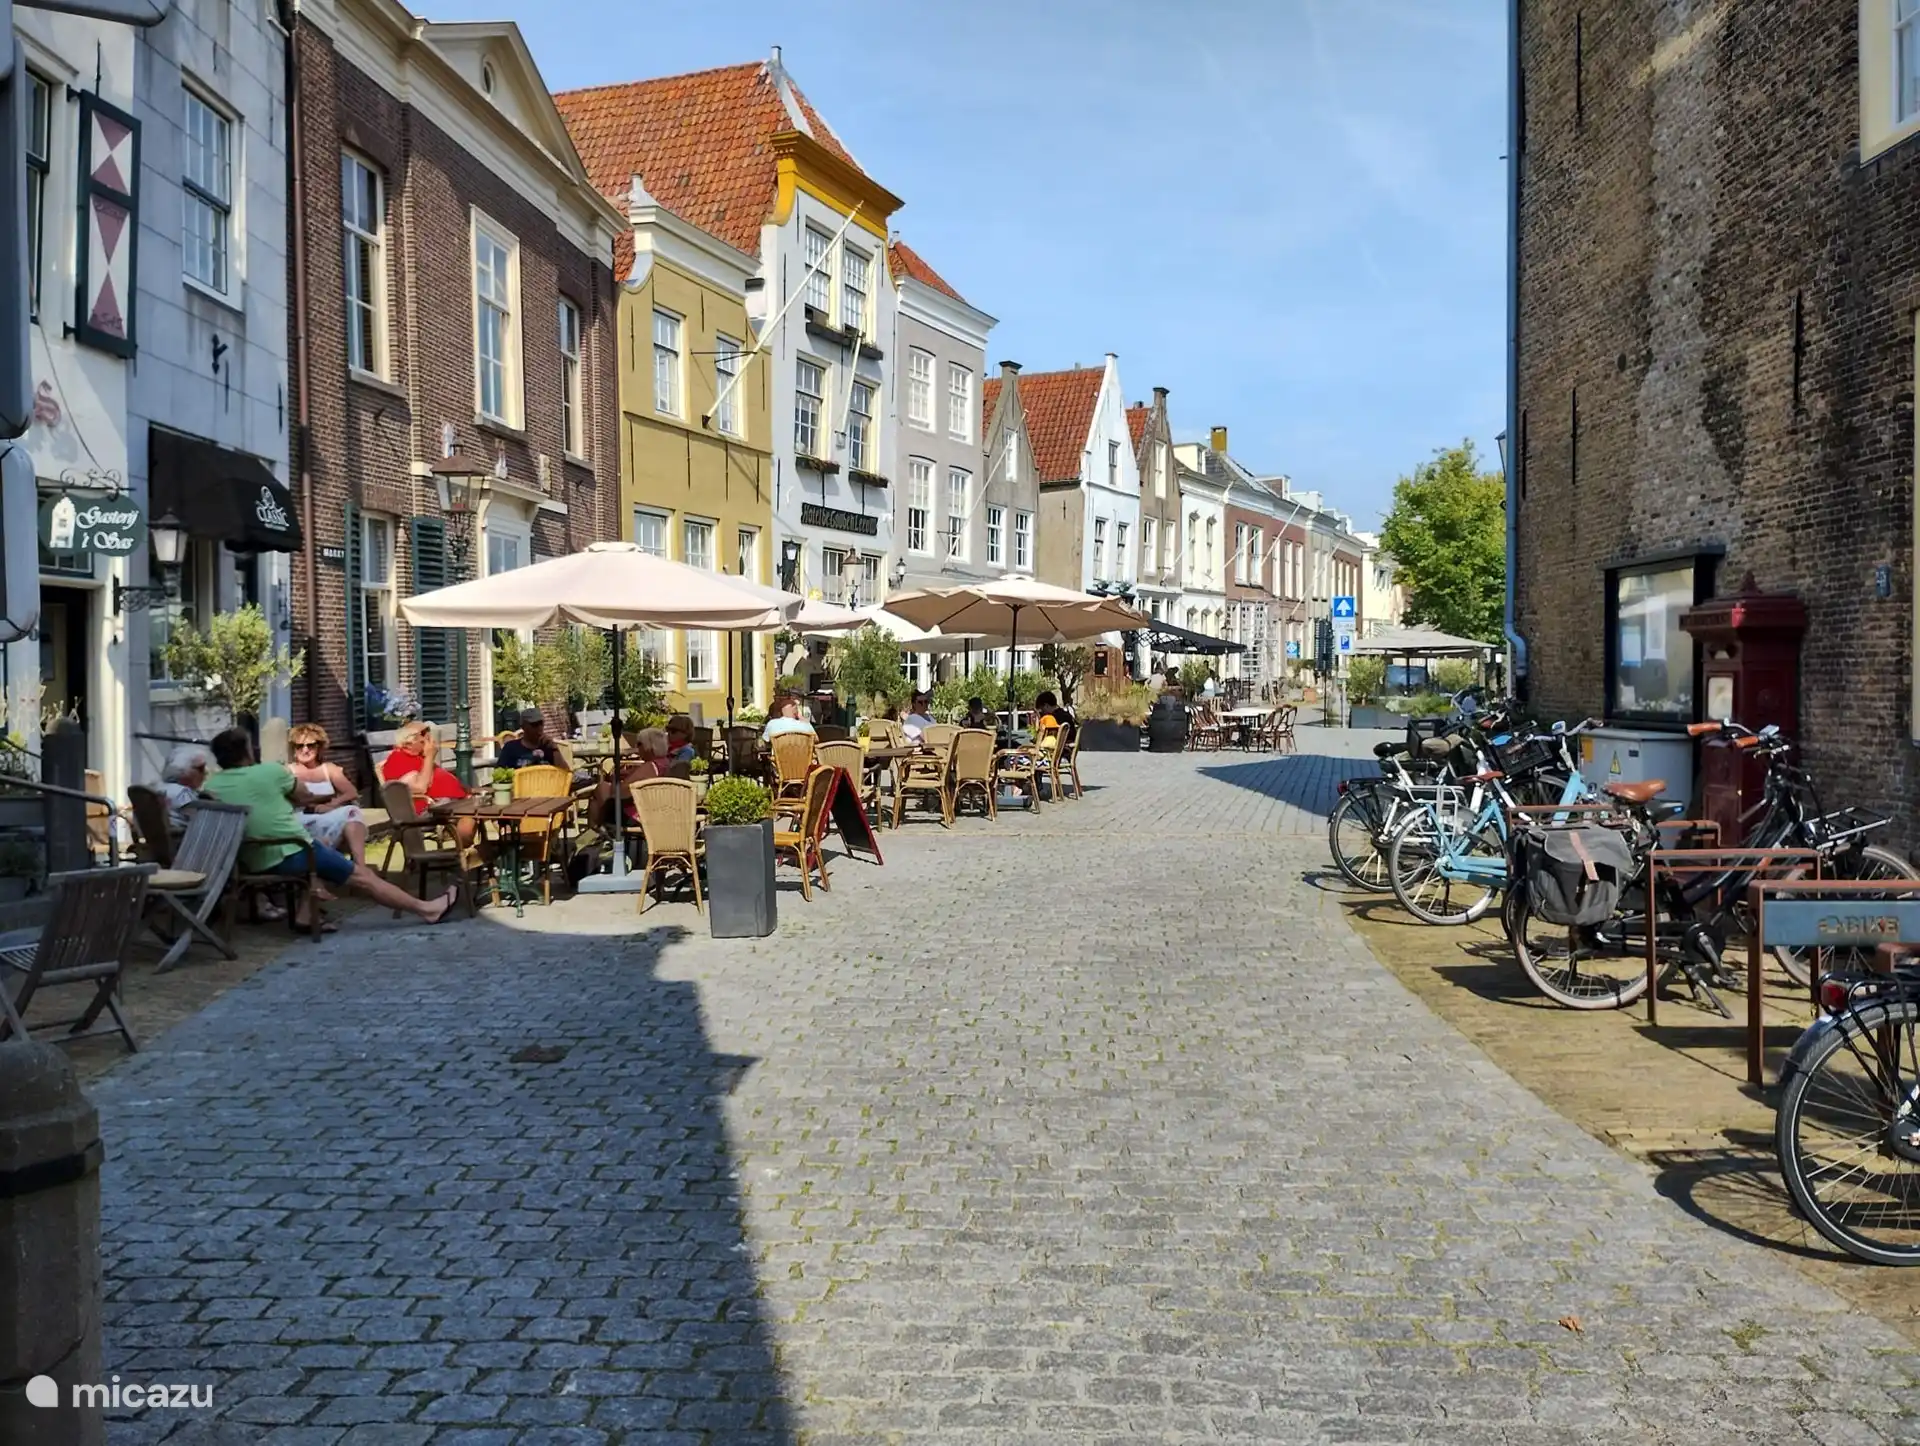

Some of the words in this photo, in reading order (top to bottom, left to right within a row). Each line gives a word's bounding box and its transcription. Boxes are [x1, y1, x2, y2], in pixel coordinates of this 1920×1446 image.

[76, 505, 139, 531] Gasterij
[802, 504, 822, 525] Hotel
[93, 531, 135, 550] Sas
